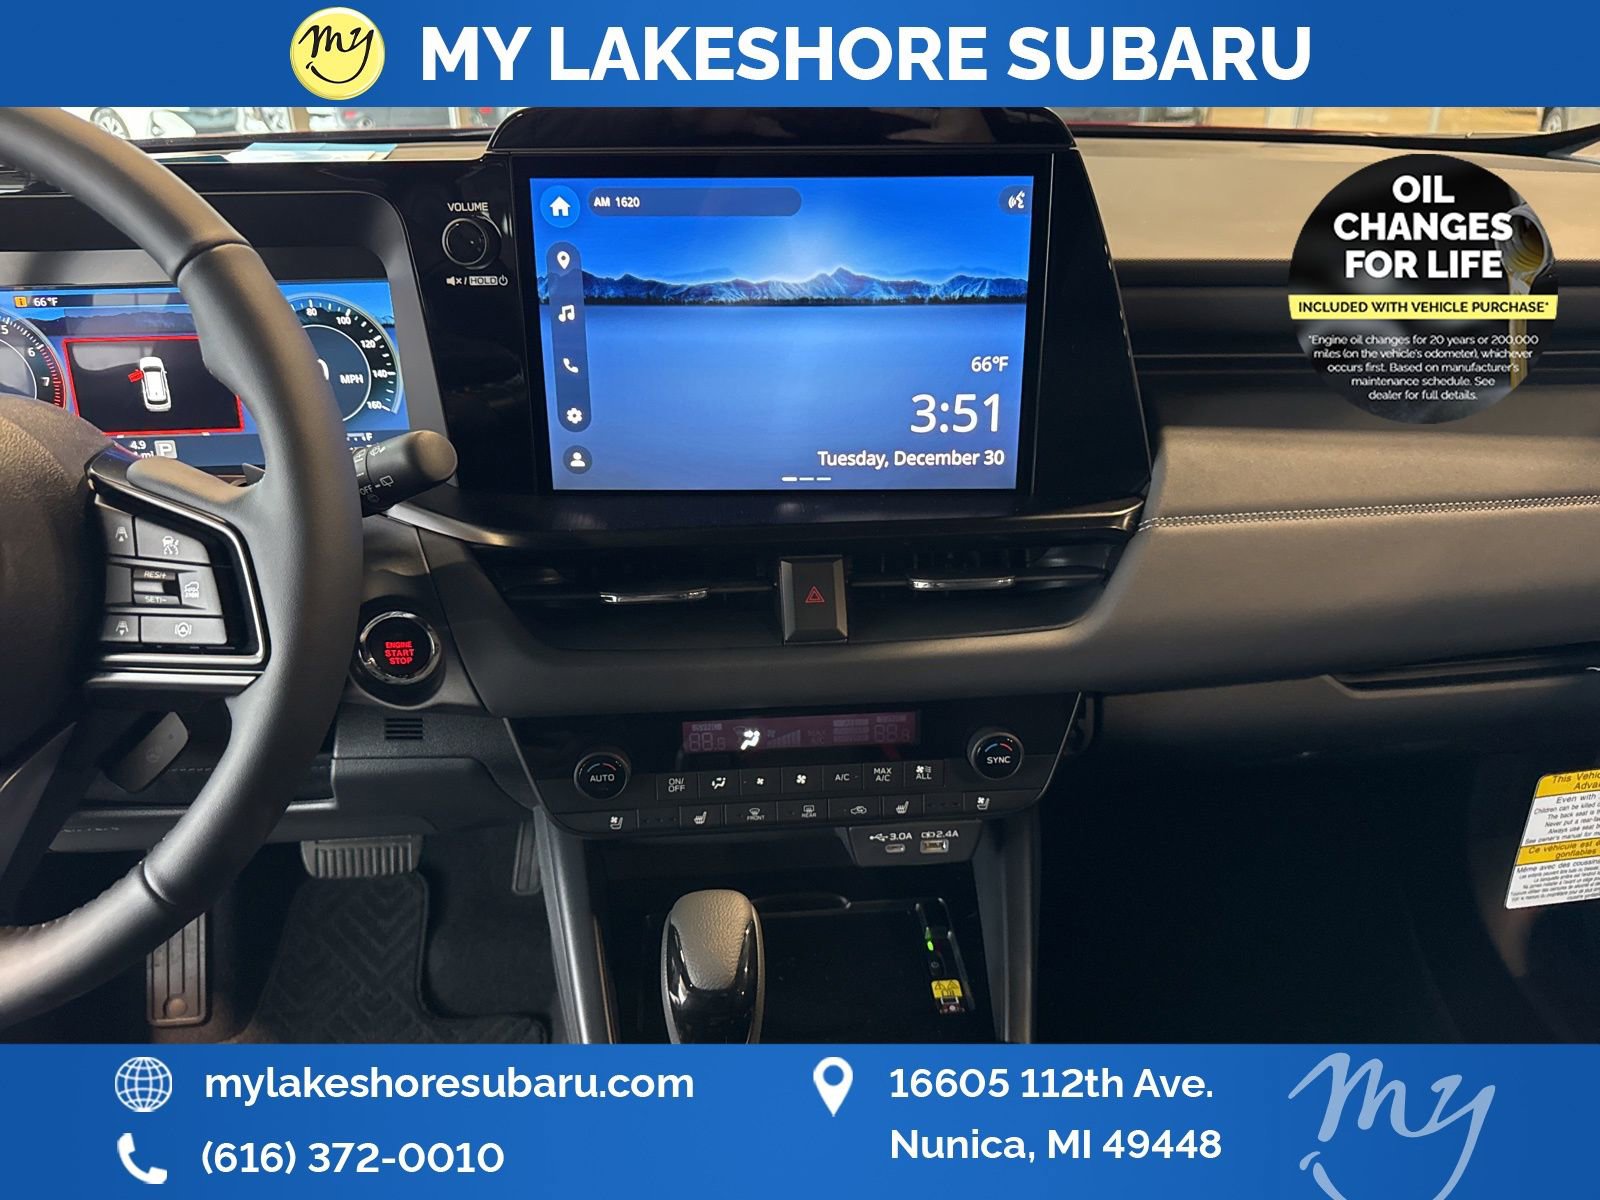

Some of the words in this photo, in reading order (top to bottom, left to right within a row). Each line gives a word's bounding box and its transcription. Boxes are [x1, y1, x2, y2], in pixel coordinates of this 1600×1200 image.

[593, 196, 611, 208] AM
[615, 196, 640, 208] 1620
[447, 202, 489, 212] VOLUME
[470, 276, 497, 285] HOLD
[306, 307, 318, 316] 80
[336, 316, 352, 325] 100
[1, 324, 9, 335] 5
[360, 340, 376, 349] 120
[28, 346, 36, 357] 6
[971, 355, 1009, 373] 66°F
[372, 369, 388, 378] 140
[41, 377, 50, 387] 7
[340, 374, 364, 384] MPH
[367, 401, 382, 410] 160
[910, 393, 1000, 433] 3:51
[130, 440, 147, 450] 4.9
[158, 442, 173, 457] P
[817, 450, 889, 470] Tuesday,
[894, 450, 980, 466] December
[983, 450, 1005, 466] 30
[360, 485, 373, 496] OFF
[385, 641, 413, 649] ENGINE
[385, 649, 415, 657] START
[389, 657, 413, 665] STOP
[986, 756, 1012, 765] SYNC
[873, 767, 892, 775] MAX
[589, 774, 615, 783] AUTO
[668, 777, 685, 785] ON/
[835, 773, 850, 781] A/C
[875, 774, 891, 782] A/C
[1552, 776, 1572, 784] This
[668, 784, 686, 793] OFF
[1556, 796, 1577, 804] Even
[889, 832, 912, 841] 3.0A
[936, 830, 959, 838] 2.4A
[1529, 846, 1541, 854] Ce
